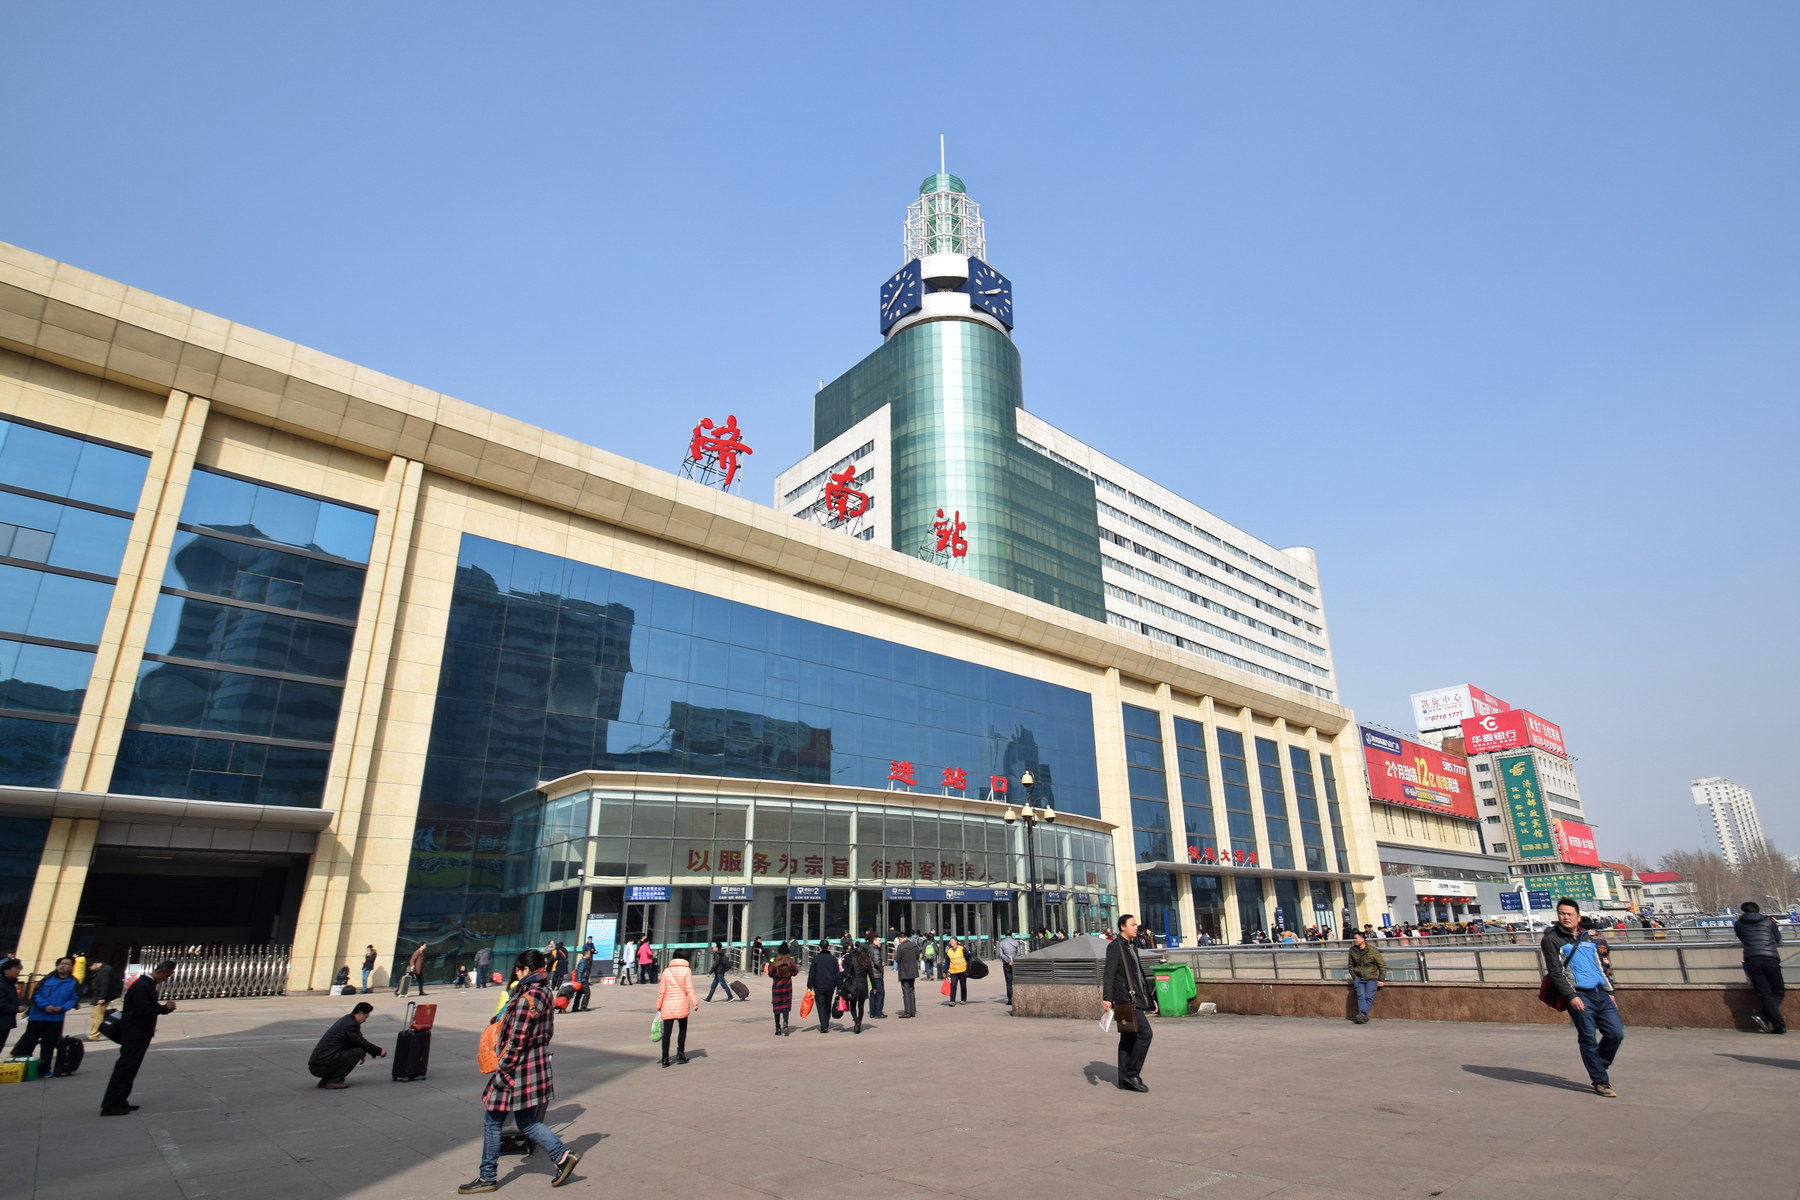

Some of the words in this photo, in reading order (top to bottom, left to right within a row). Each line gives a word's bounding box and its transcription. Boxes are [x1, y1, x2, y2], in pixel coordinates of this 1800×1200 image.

[690, 414, 968, 558] 济南站
[1470, 729, 1517, 744] 华夏银行
[887, 760, 1008, 794] 进站口
[1522, 779, 1543, 838] 济南邮政宾馆
[687, 849, 849, 878] 以服务为宗旨
[872, 857, 995, 882] 待旅客如亲人
[814, 887, 819, 895] 2
